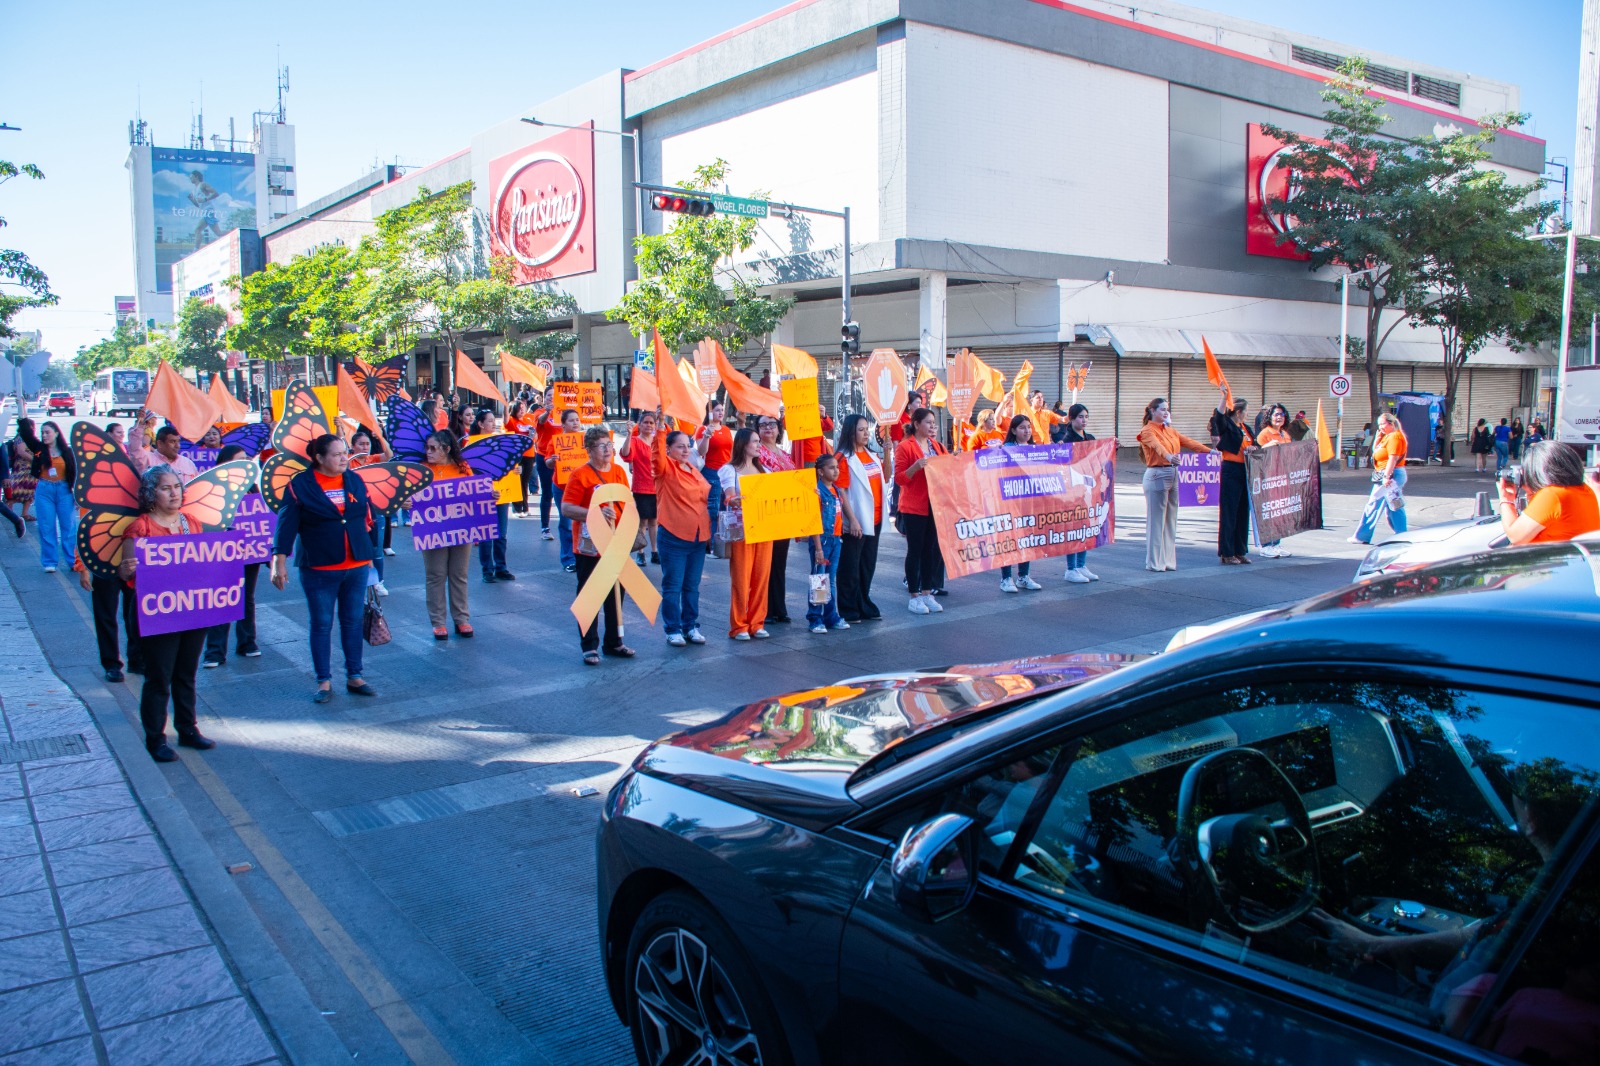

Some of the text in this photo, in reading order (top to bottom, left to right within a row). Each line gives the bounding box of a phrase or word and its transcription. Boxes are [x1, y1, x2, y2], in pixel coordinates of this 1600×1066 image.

[171, 206, 186, 217] te
[713, 200, 766, 216] ANGEL FLORES
[556, 385, 580, 395] TODAS
[1335, 380, 1346, 390] 30
[580, 406, 602, 416] TODAS
[555, 435, 579, 449] ALZA
[1178, 453, 1221, 467] VIVE SIN
[1178, 470, 1221, 484] VIOLENCIA
[433, 482, 455, 500] TE
[456, 477, 494, 497] ATES
[1261, 492, 1303, 512] SECRETARÍA
[411, 499, 498, 527] A QUIEN TE
[1261, 512, 1271, 521] DE
[1270, 509, 1281, 519] LAS
[954, 513, 1013, 541] ÚNETE
[1037, 508, 1074, 530] poner
[1073, 504, 1088, 522] fin
[1088, 509, 1095, 519] a
[1095, 502, 1104, 518] la
[413, 523, 500, 551] MALTRATE
[957, 537, 1017, 563] violencia
[1048, 525, 1066, 545] las
